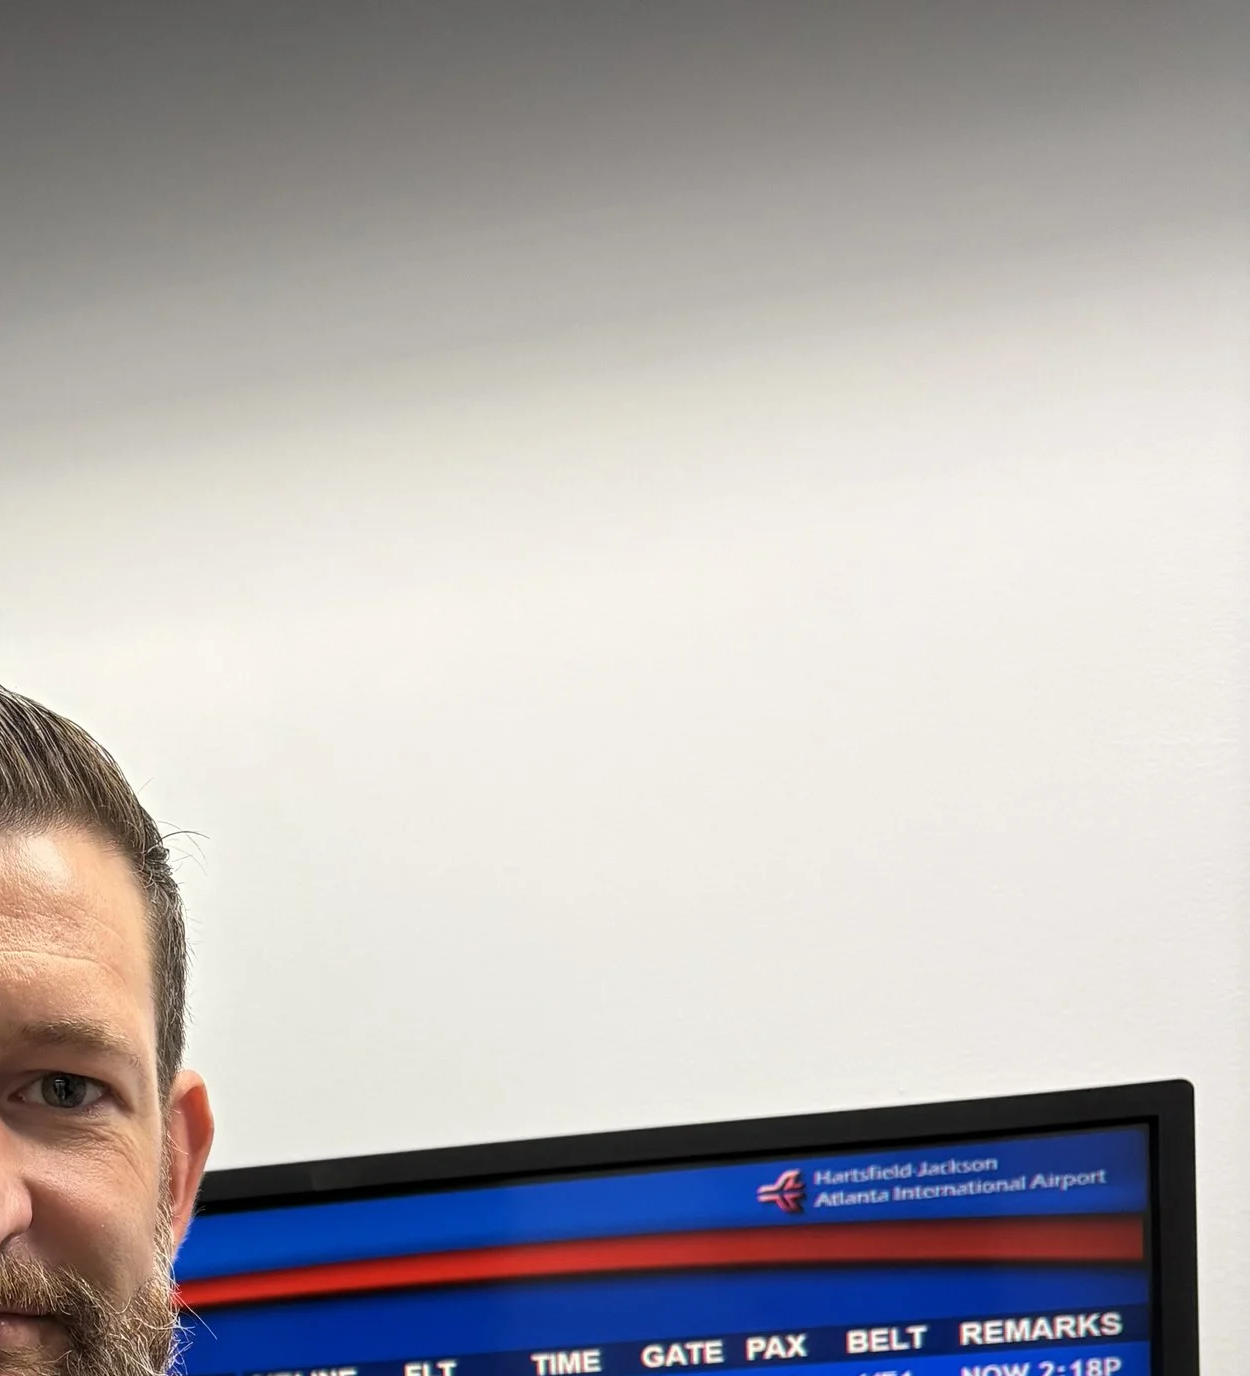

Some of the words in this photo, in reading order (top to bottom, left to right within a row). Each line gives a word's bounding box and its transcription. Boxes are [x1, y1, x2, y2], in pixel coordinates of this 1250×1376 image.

[814, 1184, 890, 1208] Atlanta
[892, 1176, 1026, 1200] International
[1028, 1170, 1107, 1190] Airport
[530, 1350, 601, 1376] TIME
[641, 1340, 724, 1368] GATE
[746, 1333, 807, 1361] PAX
[846, 1325, 928, 1354] BELT
[960, 1312, 1122, 1346] REMARKS
